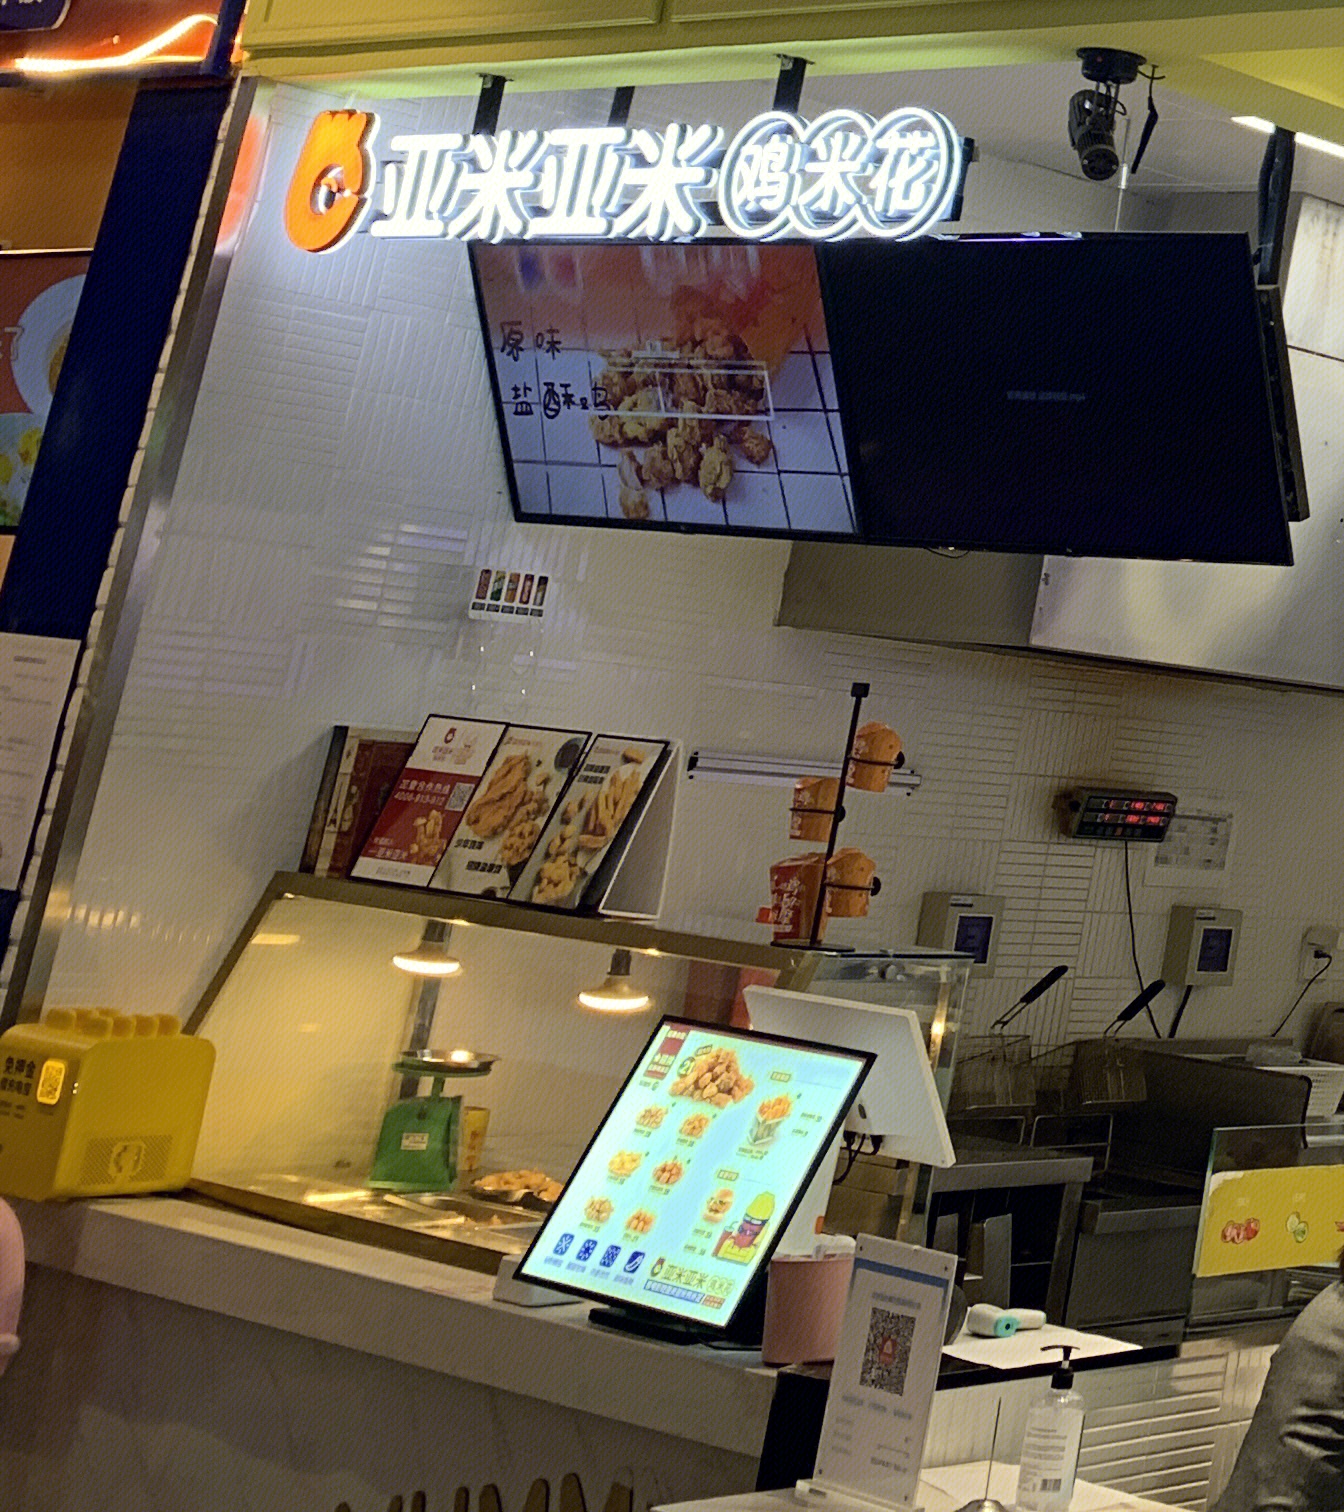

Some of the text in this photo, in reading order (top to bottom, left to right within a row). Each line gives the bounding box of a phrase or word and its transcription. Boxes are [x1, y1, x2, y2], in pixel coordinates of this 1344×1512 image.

[370, 121, 946, 243] 亚米亚米 鸡米花
[500, 320, 562, 362] 原味
[511, 380, 611, 422] 盐酥鸡
